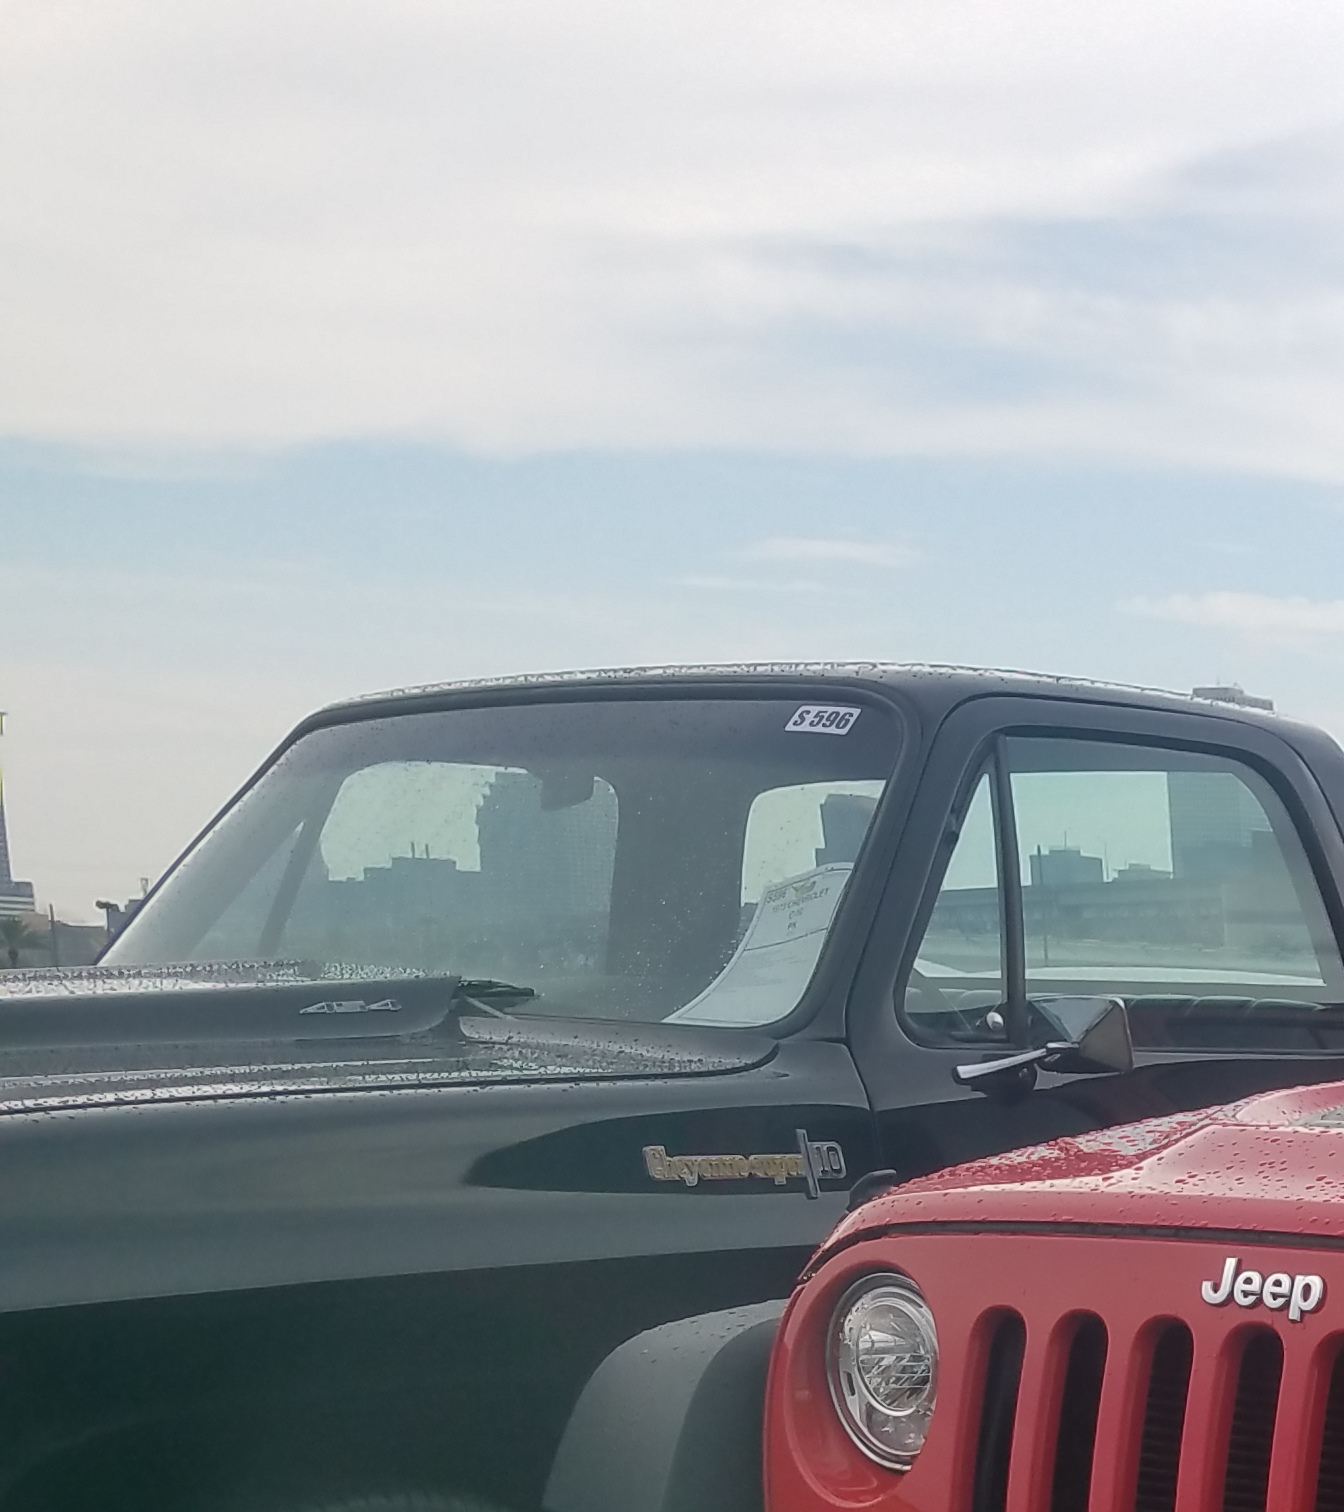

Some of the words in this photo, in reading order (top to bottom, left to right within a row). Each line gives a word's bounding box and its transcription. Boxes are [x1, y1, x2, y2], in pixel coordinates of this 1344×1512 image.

[793, 710, 811, 726] S
[809, 711, 853, 729] 596
[812, 1143, 844, 1177] 10
[1201, 1257, 1324, 1321] Jeep
